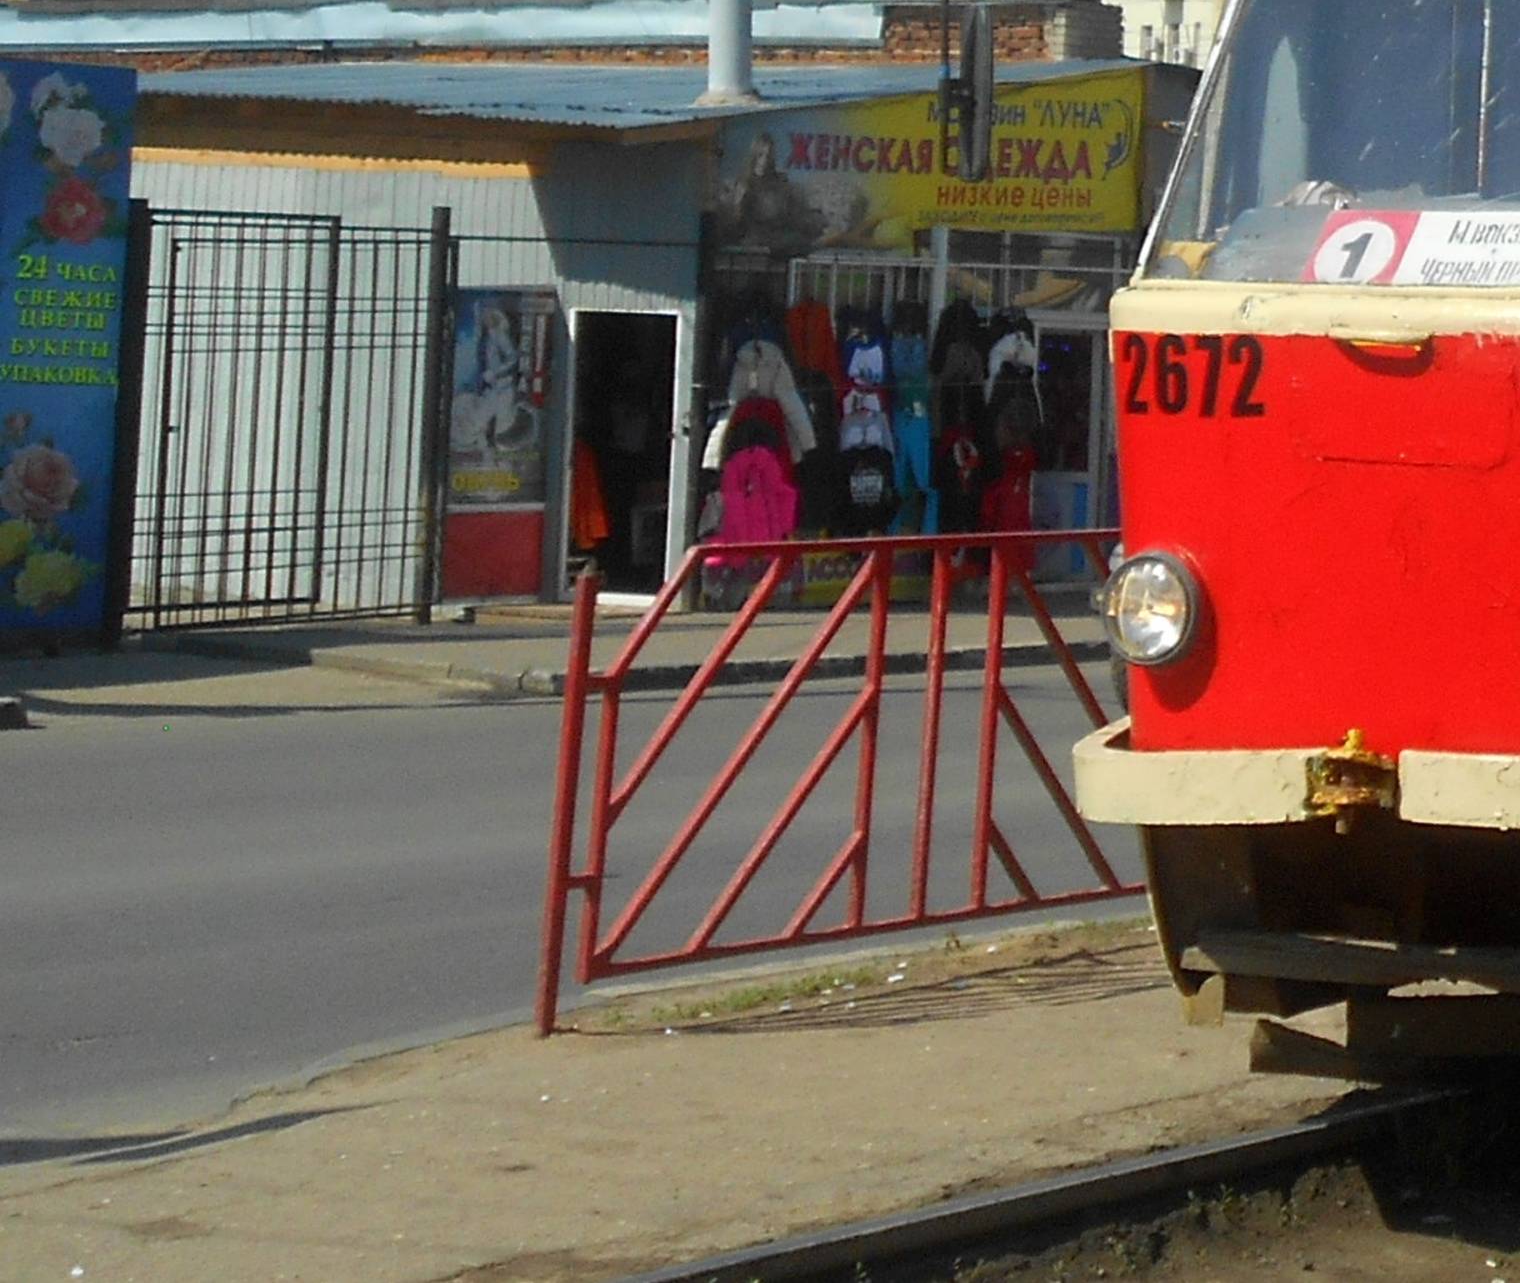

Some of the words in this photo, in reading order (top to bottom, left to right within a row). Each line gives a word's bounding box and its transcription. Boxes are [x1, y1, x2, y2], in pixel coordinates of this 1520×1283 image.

[787, 132, 934, 174] ЖЕНСКАЯ
[943, 136, 1092, 185] ОЕЖДА
[1339, 232, 1374, 279] 1
[17, 254, 48, 279] 24
[57, 262, 117, 283] ЧАСА
[14, 288, 118, 310] СВЕЖИЕ
[20, 308, 106, 330] ЦВЕТЫ
[10, 338, 110, 358] БУКЕТЫ
[0, 364, 118, 386] УПАКОВКА
[1123, 333, 1265, 418] 2672
